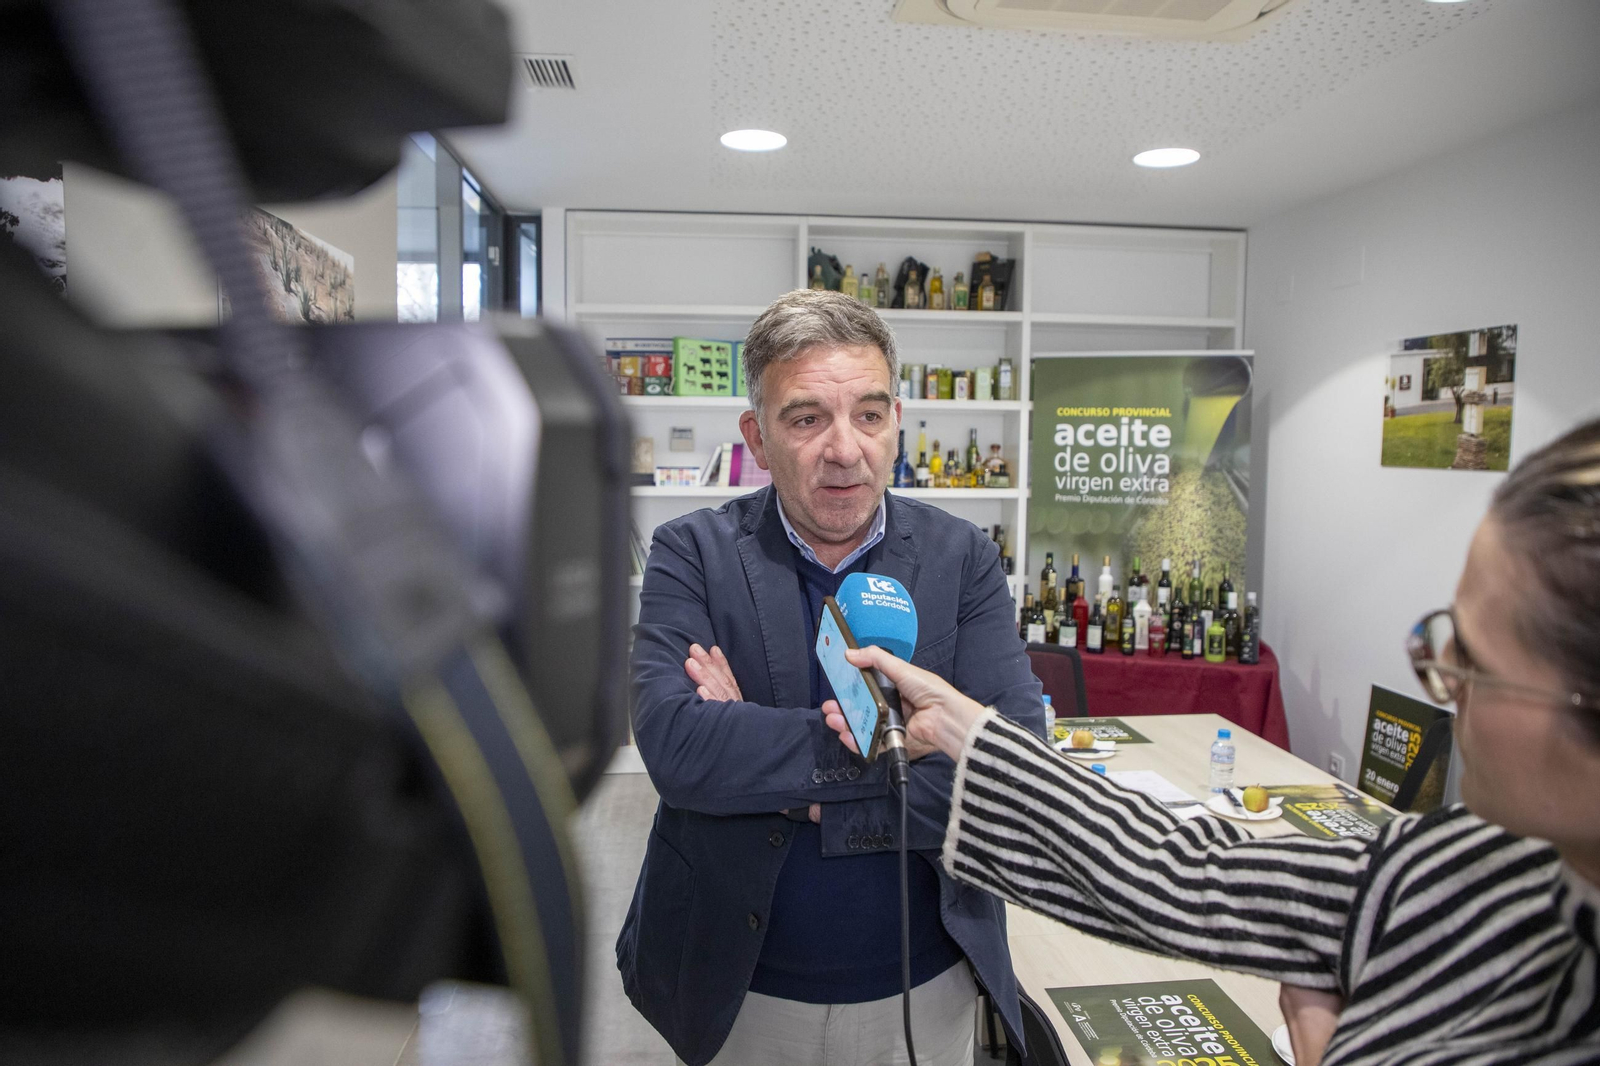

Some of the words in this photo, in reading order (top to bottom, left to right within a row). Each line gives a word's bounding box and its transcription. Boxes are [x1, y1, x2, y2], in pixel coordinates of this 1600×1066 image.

[1057, 407, 1110, 417] CONCURSO
[1112, 407, 1172, 417] PROVINCIAL
[1054, 417, 1172, 447] aceite
[1054, 446, 1090, 473] de
[1100, 447, 1170, 474] oliva
[1055, 473, 1113, 493] virgen
[1120, 475, 1169, 493] extra
[1055, 494, 1081, 503] Premio
[1082, 494, 1123, 505] Diputación
[1124, 495, 1135, 504] de
[861, 592, 909, 606] Diputación
[875, 600, 911, 613] Córdoba
[1373, 718, 1409, 742] aceite
[1372, 732, 1384, 744] de
[1385, 736, 1407, 754] oliva
[1365, 768, 1376, 781] 20
[1376, 776, 1399, 792] enero
[1109, 999, 1123, 1013] Premio
[1187, 994, 1224, 1031] CONCURSO
[1121, 997, 1153, 1028] virgen
[1146, 1029, 1175, 1058] extra
[1138, 996, 1164, 1015] de
[1156, 1018, 1198, 1056] oliva
[1160, 994, 1225, 1056] aceite
